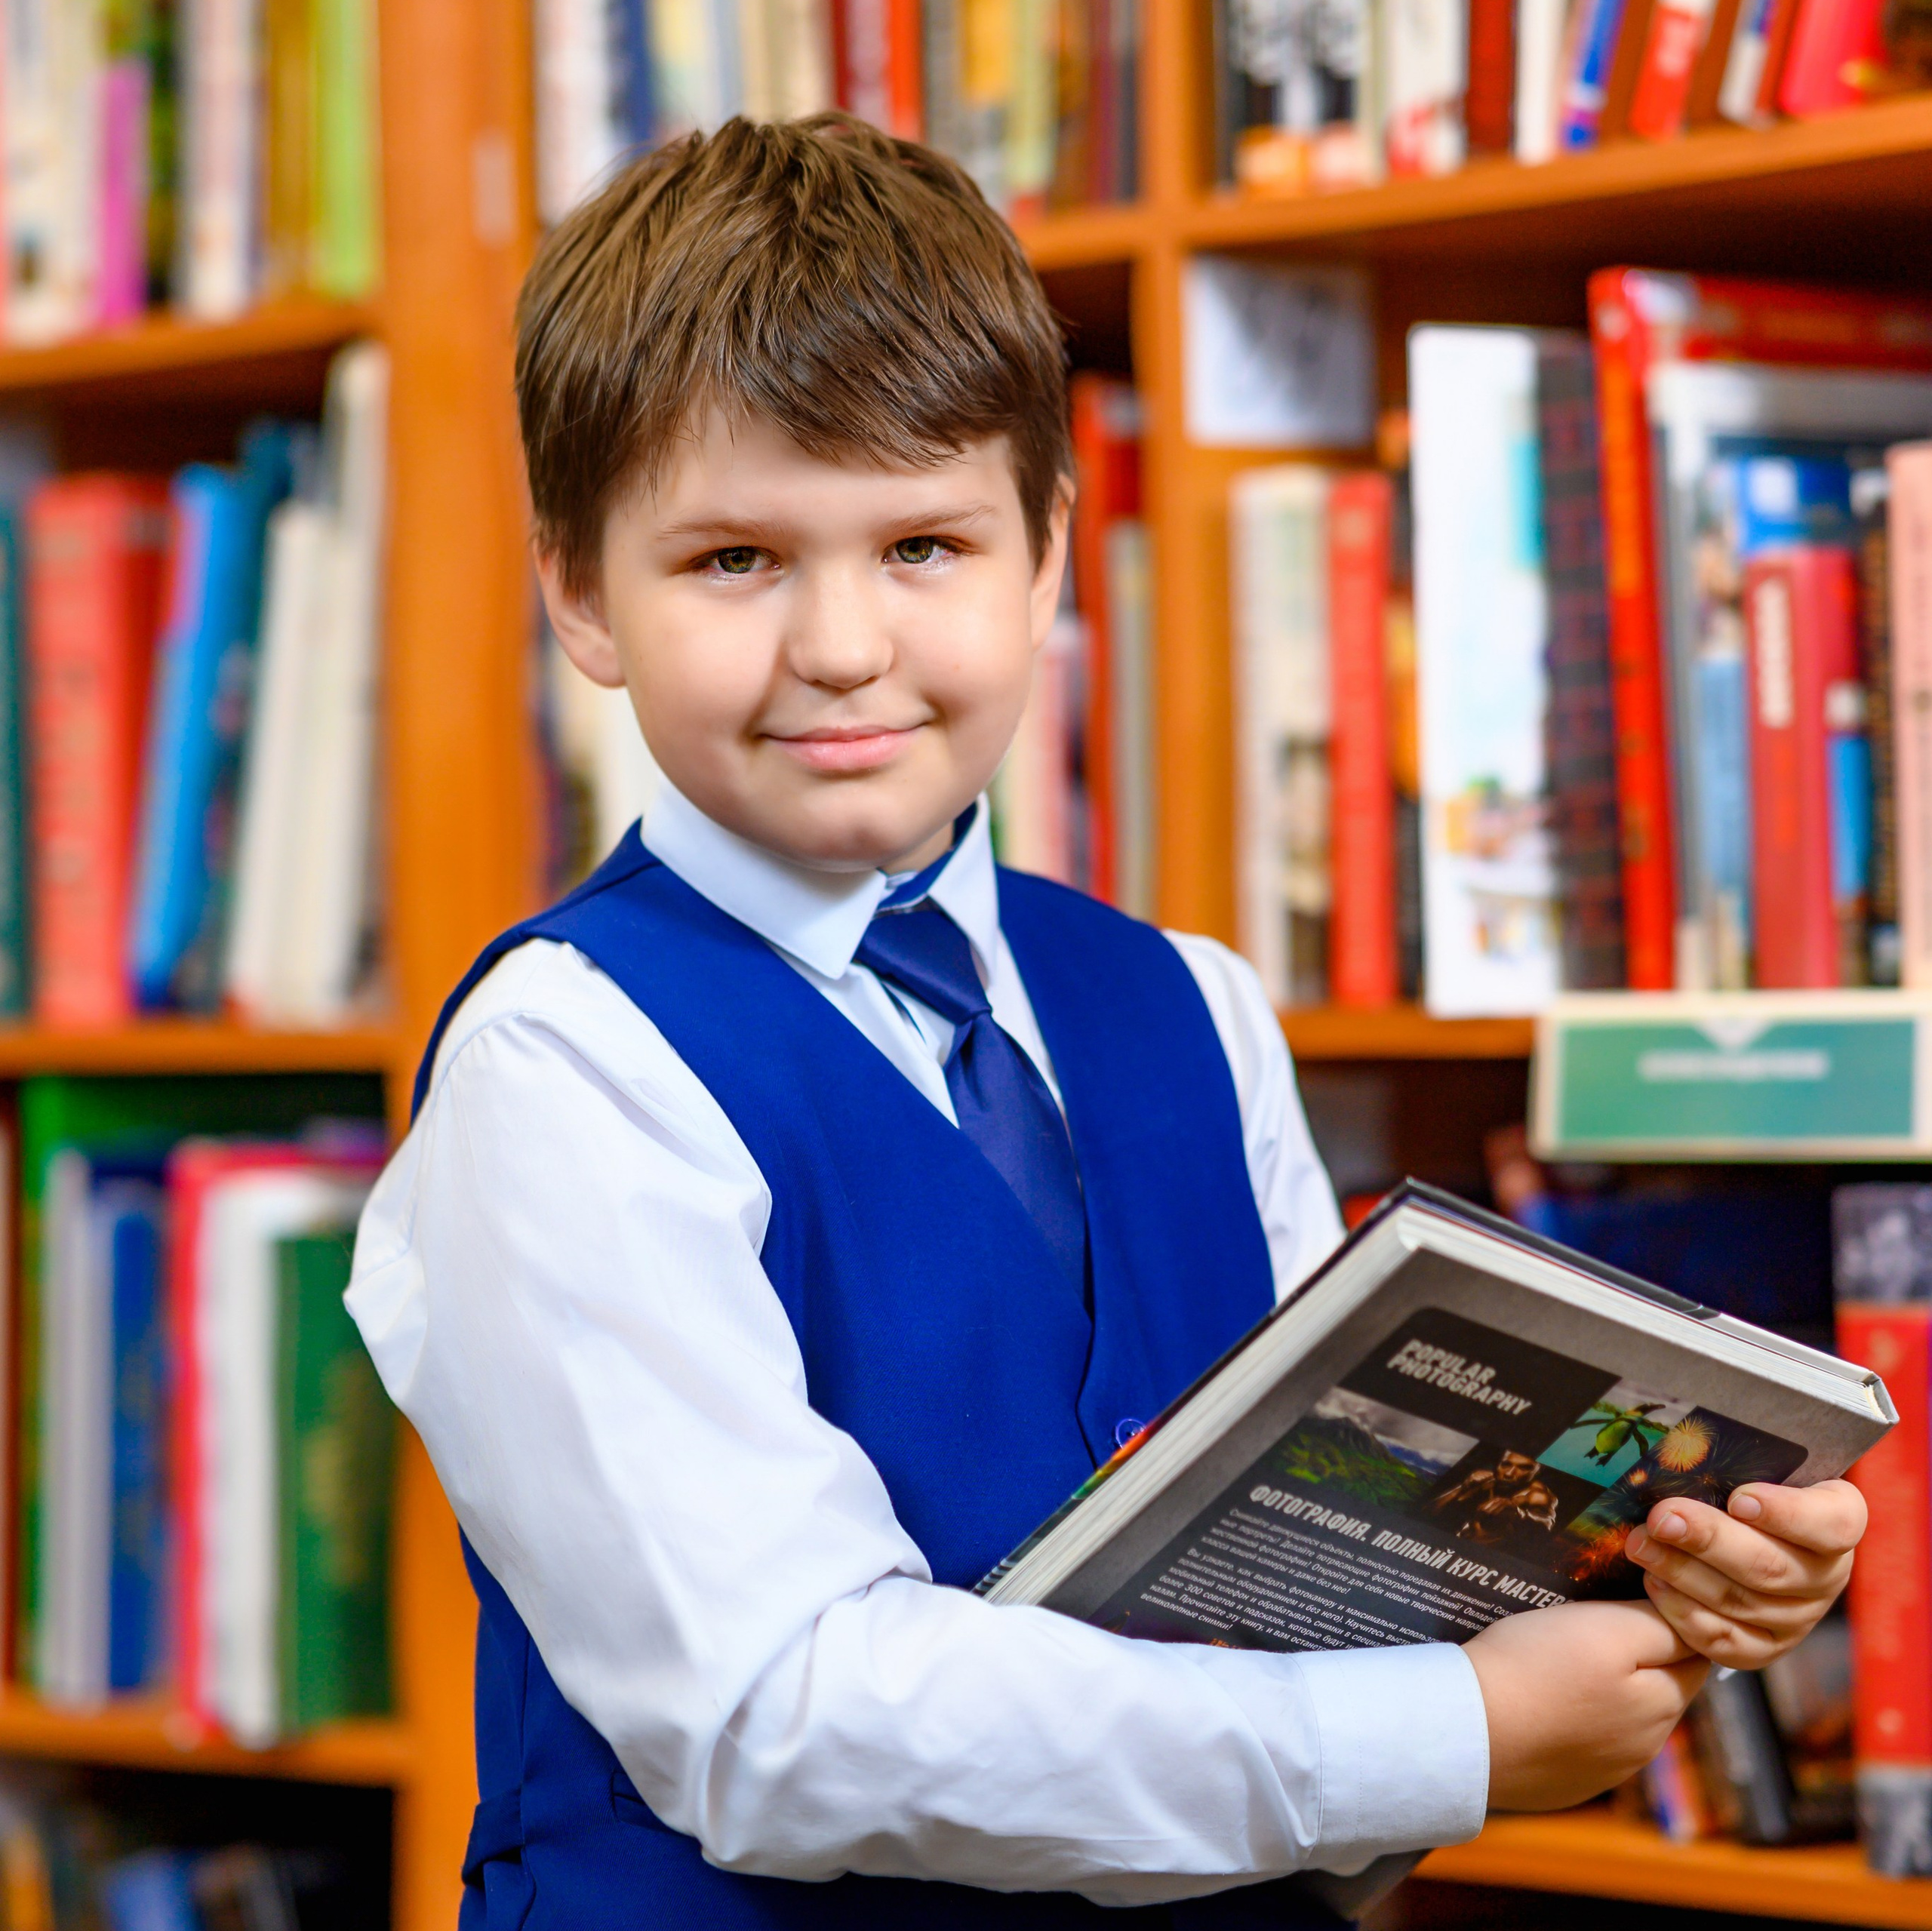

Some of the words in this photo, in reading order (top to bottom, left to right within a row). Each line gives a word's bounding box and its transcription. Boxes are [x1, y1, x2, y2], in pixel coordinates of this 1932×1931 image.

[1386, 1354, 1532, 1415] PHOTOGRAPHY
[1396, 1339, 1497, 1385] POPULAR
[1229, 1546, 1258, 1560] вашей
[1256, 1556, 1289, 1573] камеры
[1293, 1570, 1317, 1582] даже
[1315, 1578, 1332, 1588] без
[1331, 1584, 1352, 1594] нее!
[1250, 1485, 1371, 1542] ФОТОГРАФИЯ.
[1371, 1530, 1456, 1569] ПОЛНЫЙ
[1446, 1557, 1499, 1586] КУРС
[1493, 1575, 1572, 1608] МАСТЕР
[1279, 1539, 1315, 1557] Делайте
[1315, 1554, 1371, 1578] потрясающие
[1371, 1573, 1420, 1595] фотографии
[1420, 1592, 1464, 1611] пейзажей!
[1319, 1542, 1355, 1560] объекты,
[1355, 1556, 1399, 1576] полностью
[1398, 1572, 1441, 1591] передавая
[1449, 1591, 1495, 1610] движение!
[1140, 1593, 1199, 1619] великолепные
[1198, 1614, 1234, 1631] снимки!
[1149, 1584, 1177, 1599] налам.
[1178, 1594, 1226, 1616] Прочитайте
[1226, 1613, 1241, 1622] эту
[1240, 1618, 1265, 1631] книгу,
[1272, 1630, 1291, 1640] вам
[1158, 1575, 1185, 1588] более
[1184, 1583, 1204, 1595] 300
[1202, 1591, 1236, 1607] советов
[1243, 1607, 1286, 1627] подсказок,
[1287, 1623, 1322, 1639] которые
[1322, 1634, 1346, 1647] будут
[1168, 1567, 1216, 1588] мобильный
[1215, 1584, 1250, 1600] телефон
[1257, 1600, 1312, 1624] обрабатывать
[1313, 1620, 1345, 1635] снимки
[1177, 1557, 1237, 1583] полнительным
[1236, 1579, 1299, 1606] оборудованием
[1305, 1604, 1321, 1614] без
[1320, 1610, 1344, 1623] него).
[1344, 1618, 1385, 1637] Научитесь
[1186, 1547, 1201, 1558] Вы
[1237, 1567, 1254, 1577] как
[1253, 1573, 1287, 1590] выбрать
[1288, 1586, 1338, 1609] фотокамеру
[1345, 1607, 1398, 1630] максимально
[1258, 1545, 1312, 1568] фотографии!
[1311, 1563, 1349, 1582] Откройте
[1346, 1578, 1364, 1588] для
[1364, 1584, 1385, 1595] себя
[1383, 1591, 1411, 1604] новые
[1410, 1600, 1456, 1621] творческие
